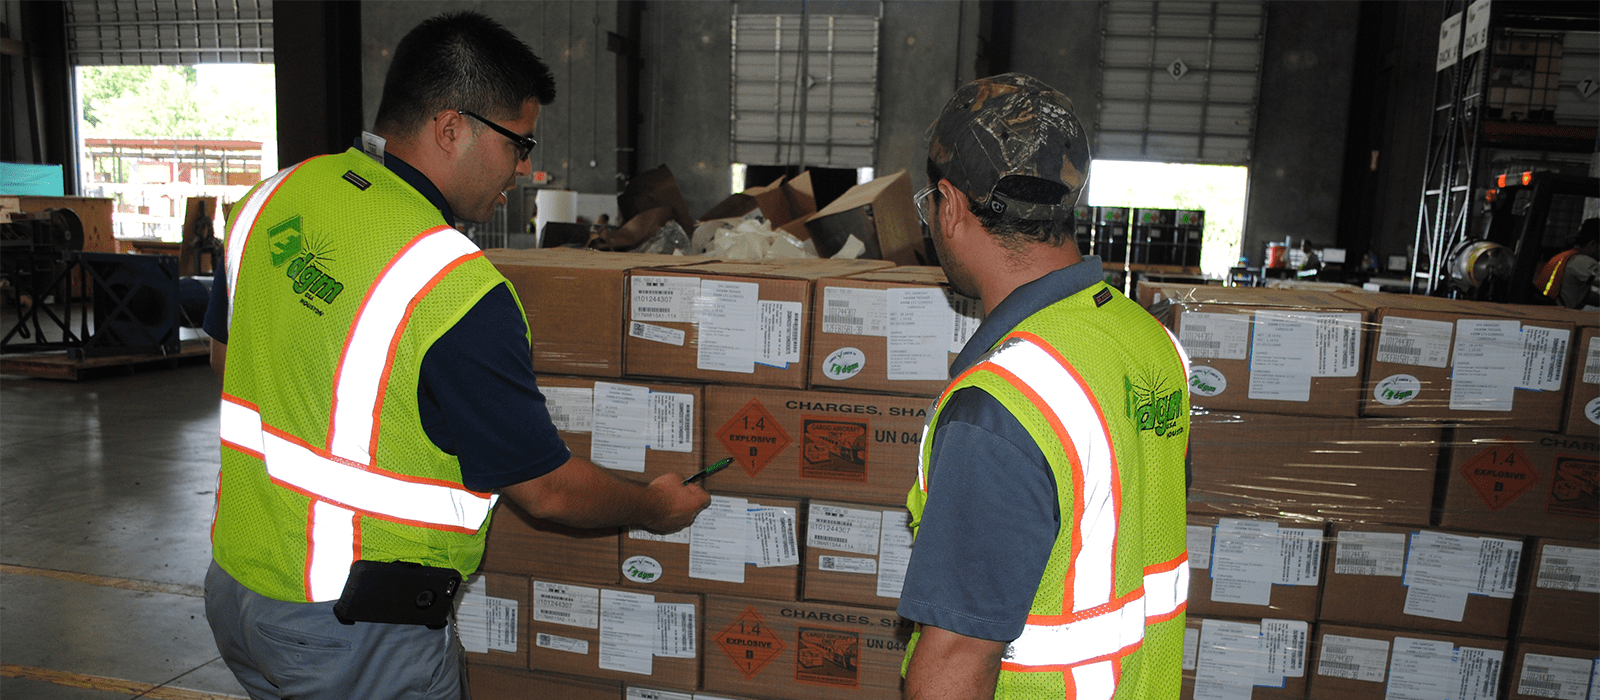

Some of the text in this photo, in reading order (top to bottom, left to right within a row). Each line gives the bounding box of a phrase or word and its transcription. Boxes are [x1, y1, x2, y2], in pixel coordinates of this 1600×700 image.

[1173, 62, 1181, 76] 8
[1584, 79, 1592, 94] 7
[286, 252, 344, 304] dgm
[785, 400, 882, 416] CHARGES,
[741, 416, 765, 431] 1.4
[729, 434, 777, 445] EXPLOSIVE
[875, 430, 896, 445] UN
[1540, 438, 1600, 452] CHAR
[1492, 450, 1515, 467] 1.4
[1474, 468, 1526, 481] EXPLOSIVE
[780, 608, 875, 626] CHARGES,
[739, 621, 761, 636] 1.4
[726, 637, 772, 648] EXPLOSIVE
[867, 639, 884, 650] UN
